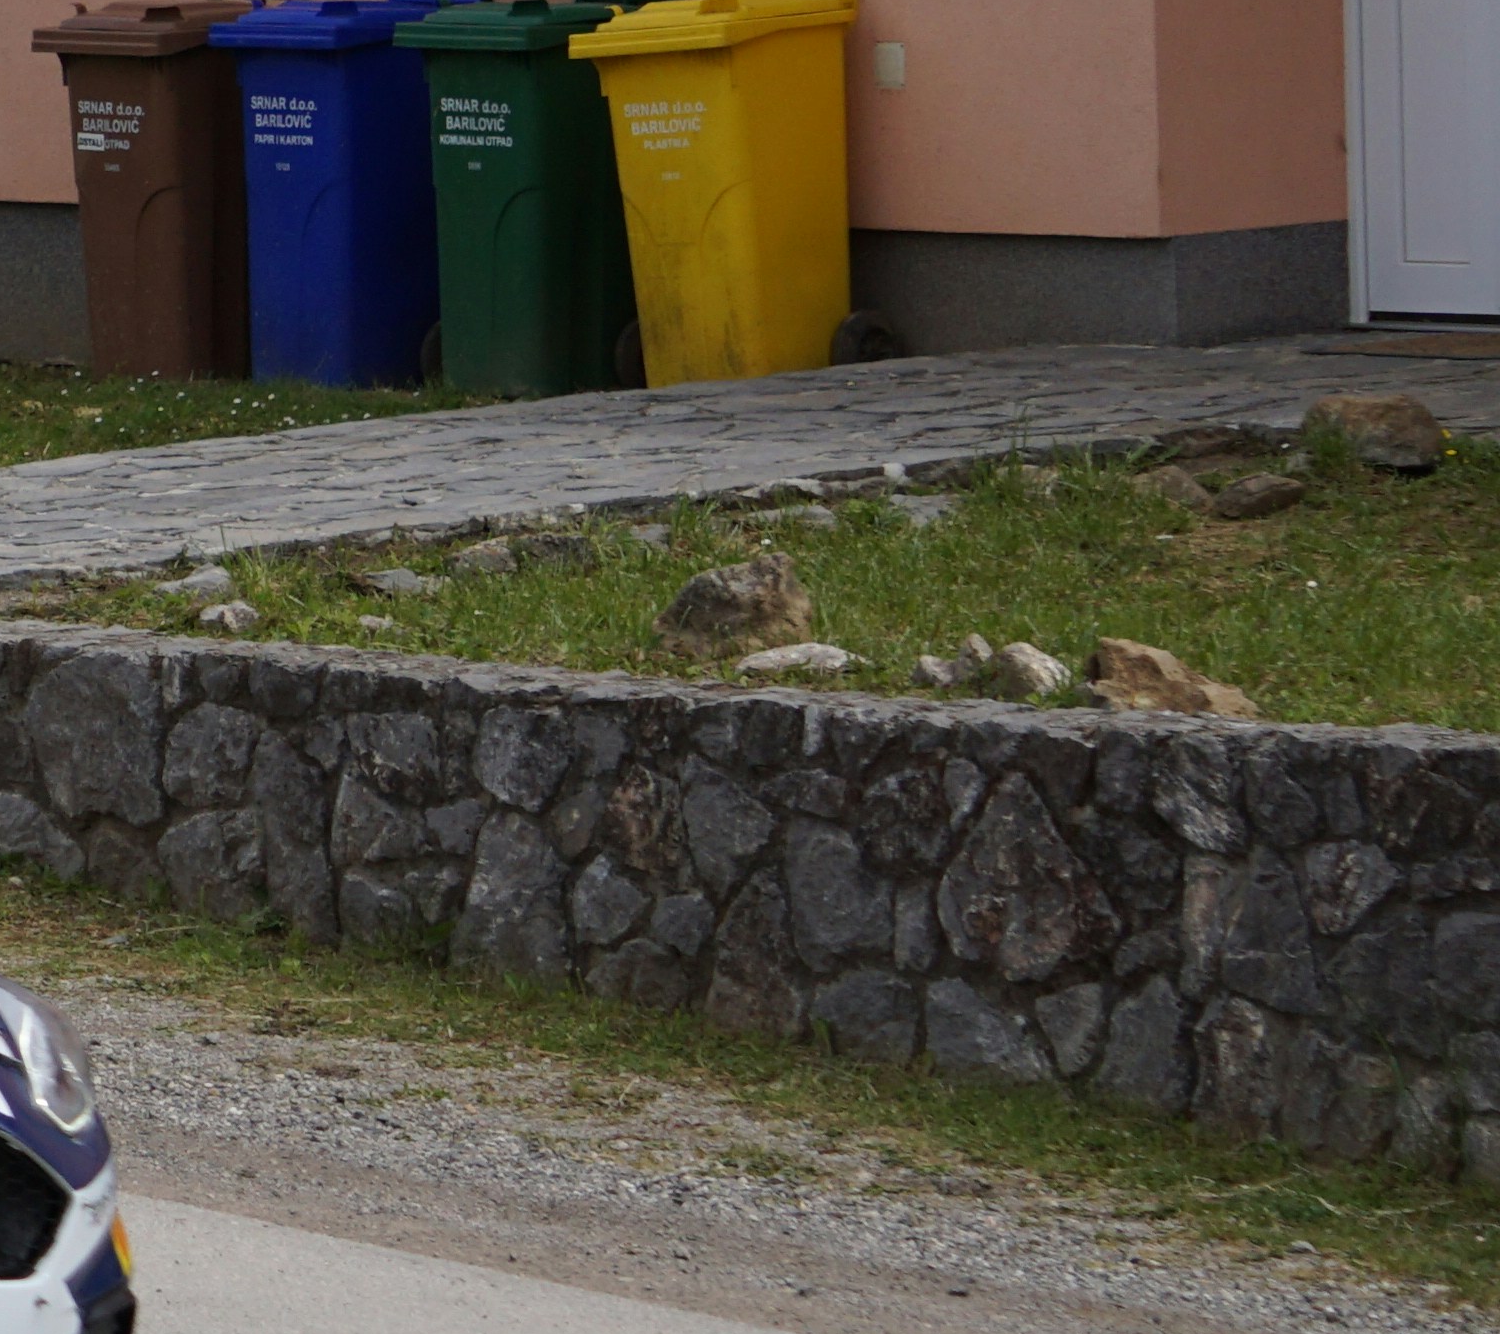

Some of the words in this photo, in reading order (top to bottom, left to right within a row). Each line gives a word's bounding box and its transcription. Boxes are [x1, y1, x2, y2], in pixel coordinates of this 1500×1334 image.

[78, 100, 113, 116] SRNAR
[117, 103, 145, 116] d.o.o.
[250, 96, 287, 111] SRNAR
[289, 97, 318, 111] d.o.o.
[440, 98, 479, 113] SRNAR
[482, 100, 511, 114] d.o.o.
[624, 102, 669, 118] SRNAR
[672, 101, 707, 115] d.o.o.
[279, 134, 313, 146] KARTON
[439, 134, 484, 147] KOMUNALNI
[486, 136, 513, 148] OTPAD
